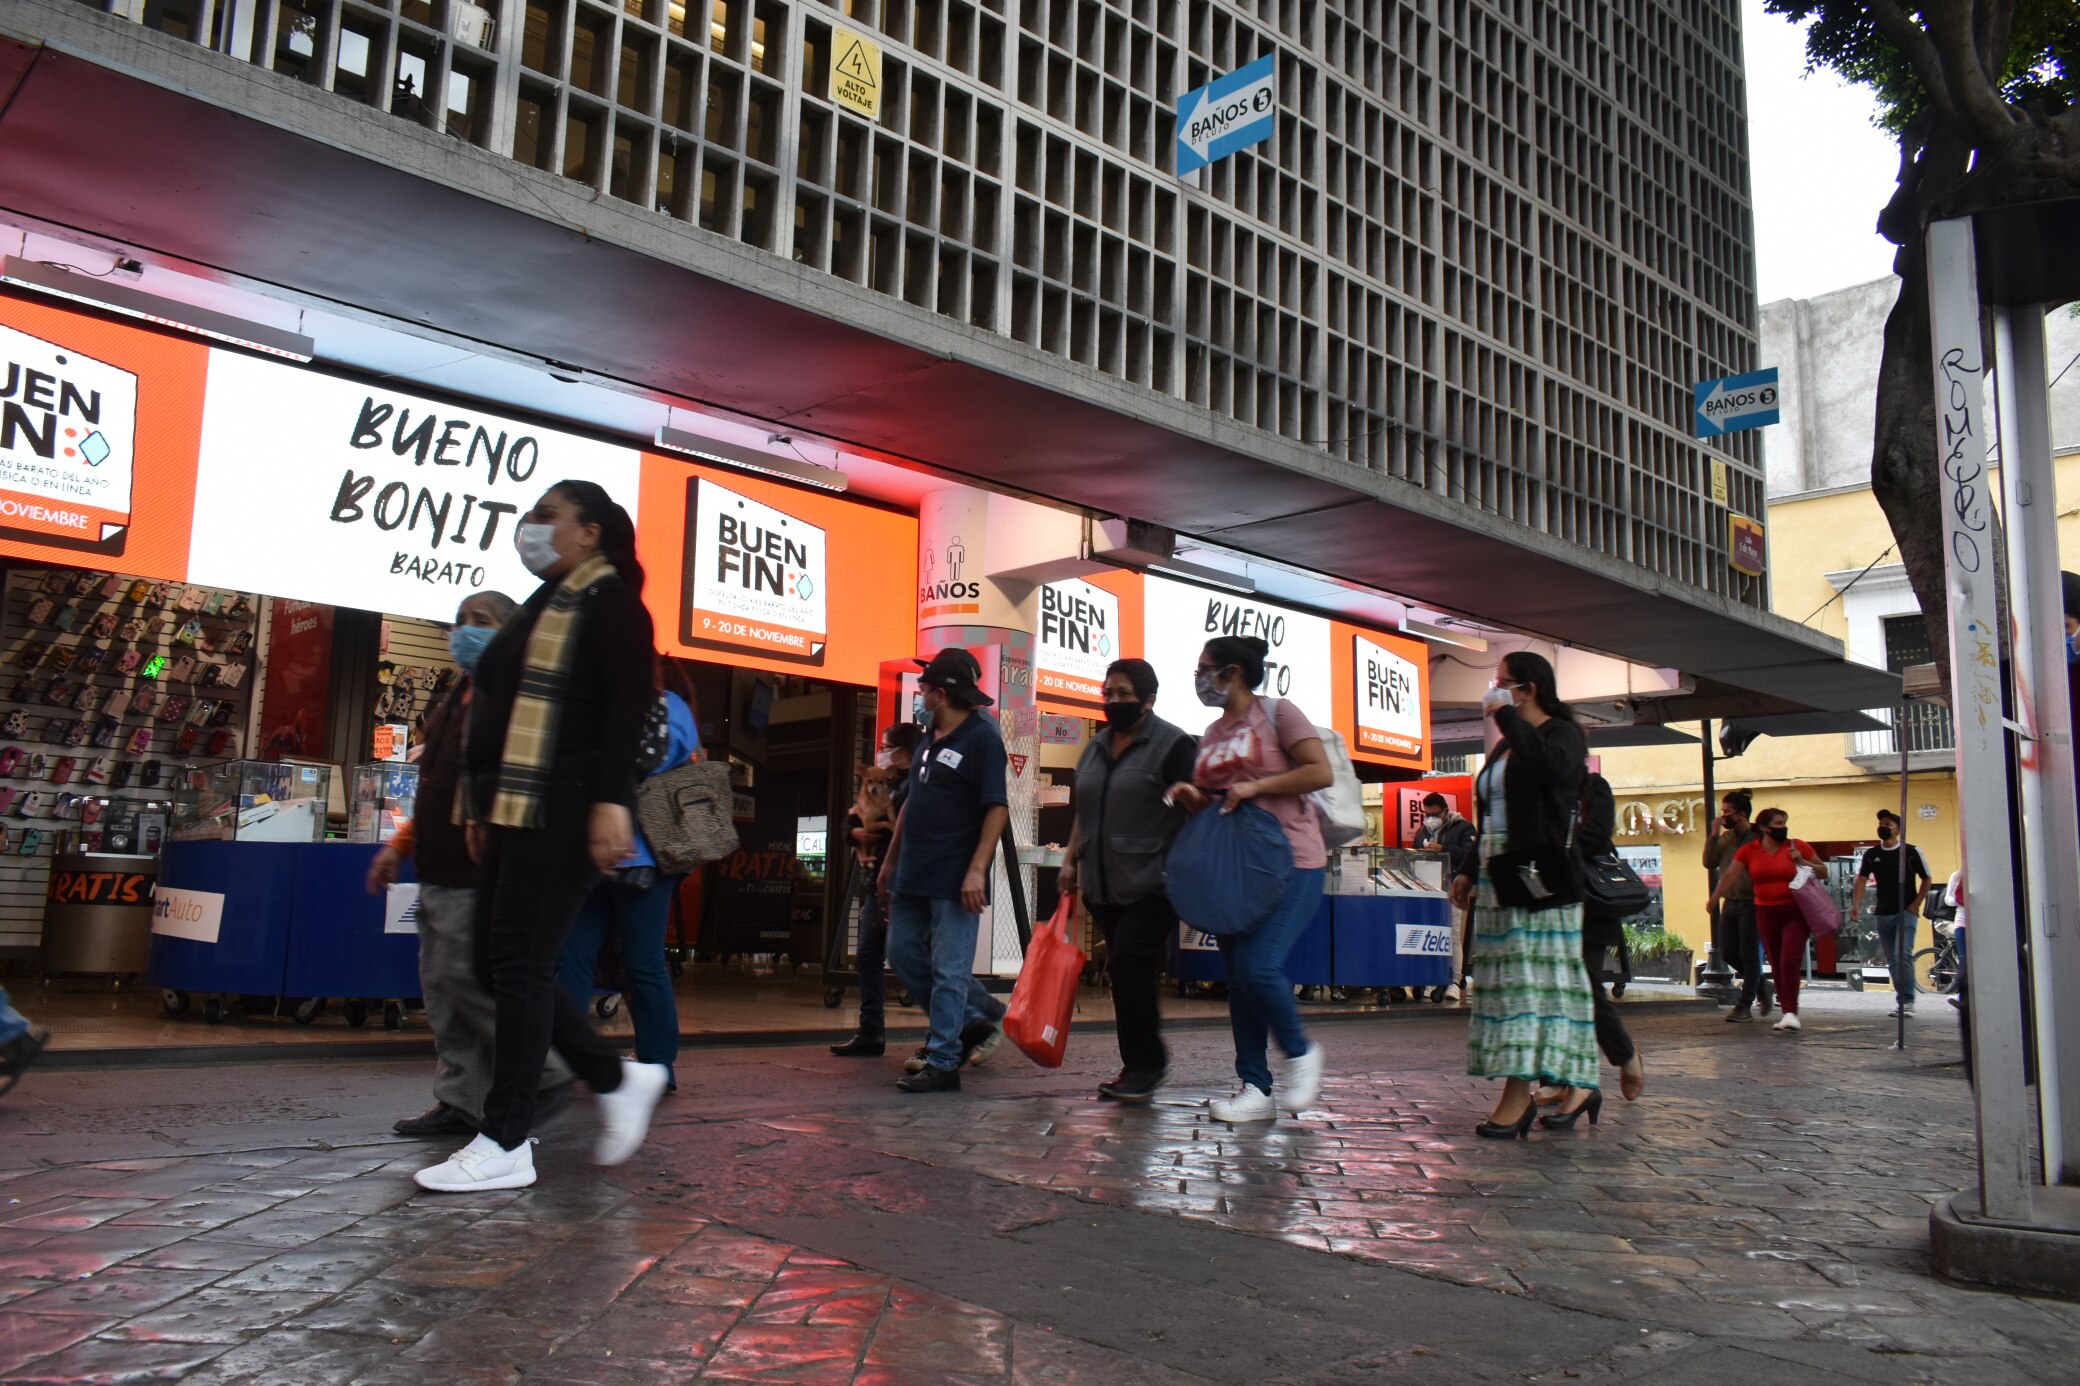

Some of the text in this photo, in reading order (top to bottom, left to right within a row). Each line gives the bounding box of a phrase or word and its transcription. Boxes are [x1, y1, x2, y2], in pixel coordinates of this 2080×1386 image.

[837, 86, 873, 109] VOLTAJE
[845, 80, 866, 96] ALTO
[1191, 98, 1248, 139] BAÑOS
[1191, 123, 1230, 145] DE LUJO
[0, 361, 101, 425] UEN
[1706, 392, 1756, 413] BAÑOS
[350, 396, 538, 486] BUENO
[16, 462, 60, 479] BARATO
[62, 471, 81, 484] DEL
[43, 478, 59, 490] EN
[0, 499, 89, 529] OVIEMBRE
[329, 469, 518, 552] BONIT
[718, 512, 807, 570] BUEN
[390, 551, 485, 588] BARATO
[920, 579, 980, 604] BAÑOS
[1041, 584, 1105, 631] BUEN
[290, 616, 318, 636] héroes
[703, 618, 711, 629] 9
[718, 620, 731, 633] 20
[733, 623, 747, 637] DE
[749, 626, 805, 648] NOVIEMBRE
[1043, 676, 1053, 686] 20
[1054, 678, 1064, 688] DE
[1065, 681, 1104, 697] NOVIEMBR
[1367, 658, 1410, 694] BUEN
[1368, 680, 1400, 714] FIN
[1055, 726, 1068, 737] No
[155, 896, 203, 922] artAuto
[1421, 929, 1450, 953] telce
